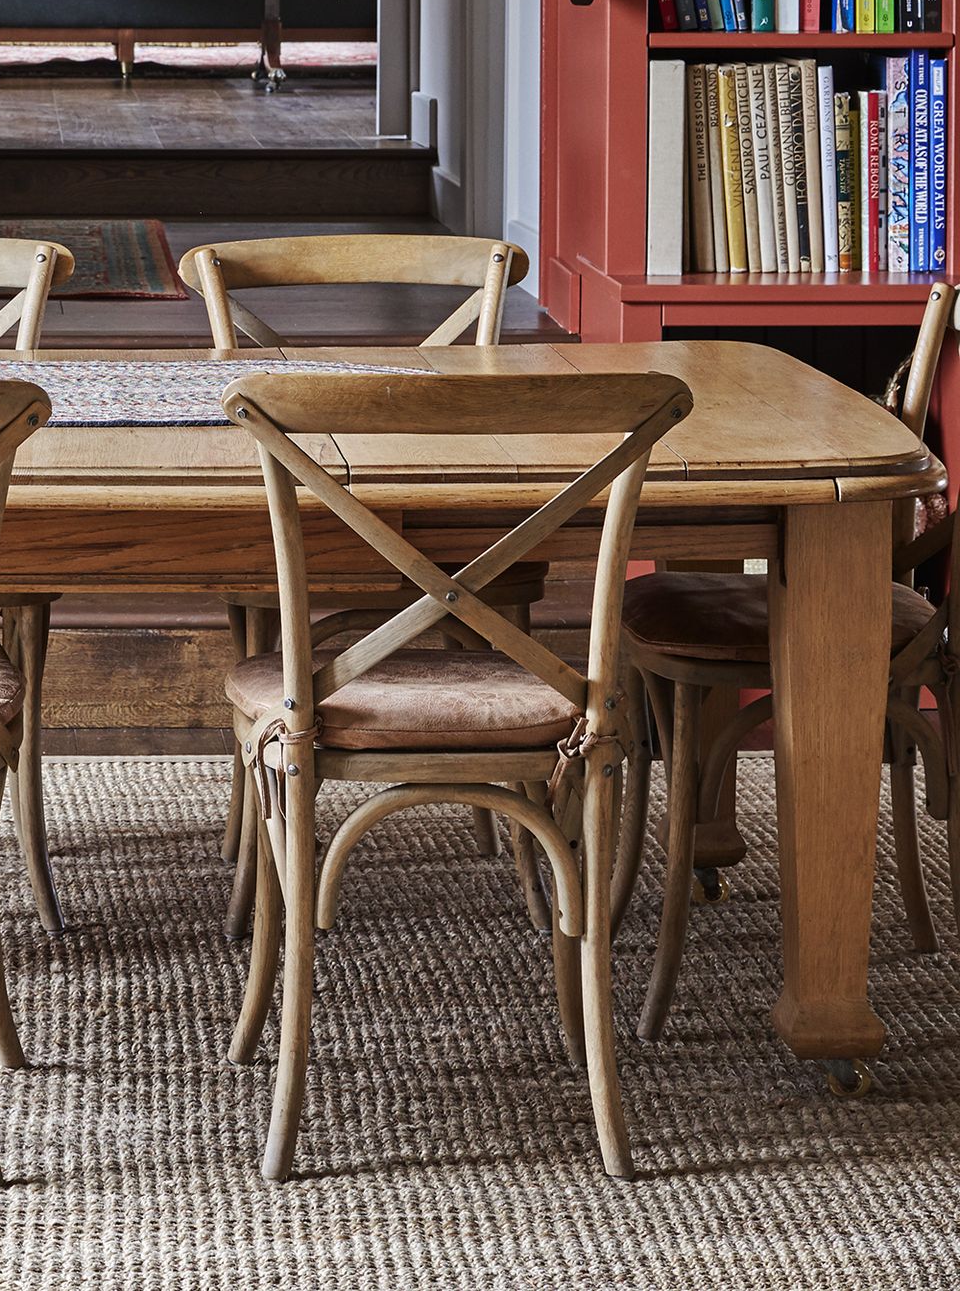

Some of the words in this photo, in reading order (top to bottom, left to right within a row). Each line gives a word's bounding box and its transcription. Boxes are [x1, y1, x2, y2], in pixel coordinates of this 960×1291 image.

[708, 68, 719, 127] REMBRANDT
[736, 66, 750, 133] BOTTICELLI
[752, 69, 766, 139] CEZANNE
[768, 68, 778, 121] DRAWINGS
[777, 65, 790, 115] BELLINI
[804, 65, 816, 133] VELAZQUEZ
[823, 77, 833, 124] GARDENS
[915, 89, 928, 126] CONCISE
[693, 68, 705, 158] IMPRESSIONISTS
[793, 109, 803, 126] DA
[933, 100, 944, 141] GREAT
[772, 126, 780, 148] AND
[783, 120, 796, 186] GIOVANNI
[825, 137, 834, 171] CORFU
[870, 120, 879, 152] ROME
[915, 127, 928, 157] ATLAS
[697, 163, 706, 182] THE
[730, 154, 743, 207] VINCENT
[741, 139, 755, 194] SANDRO
[758, 145, 770, 179] PAUL
[774, 153, 784, 207] PAINTINGS
[792, 133, 807, 204] LEONARDO
[870, 155, 879, 199] REBORN
[915, 158, 928, 169] OF
[915, 170, 928, 190] THE
[933, 144, 944, 189] WORLD
[915, 191, 928, 223] WORLD
[933, 192, 944, 229] ATLAS
